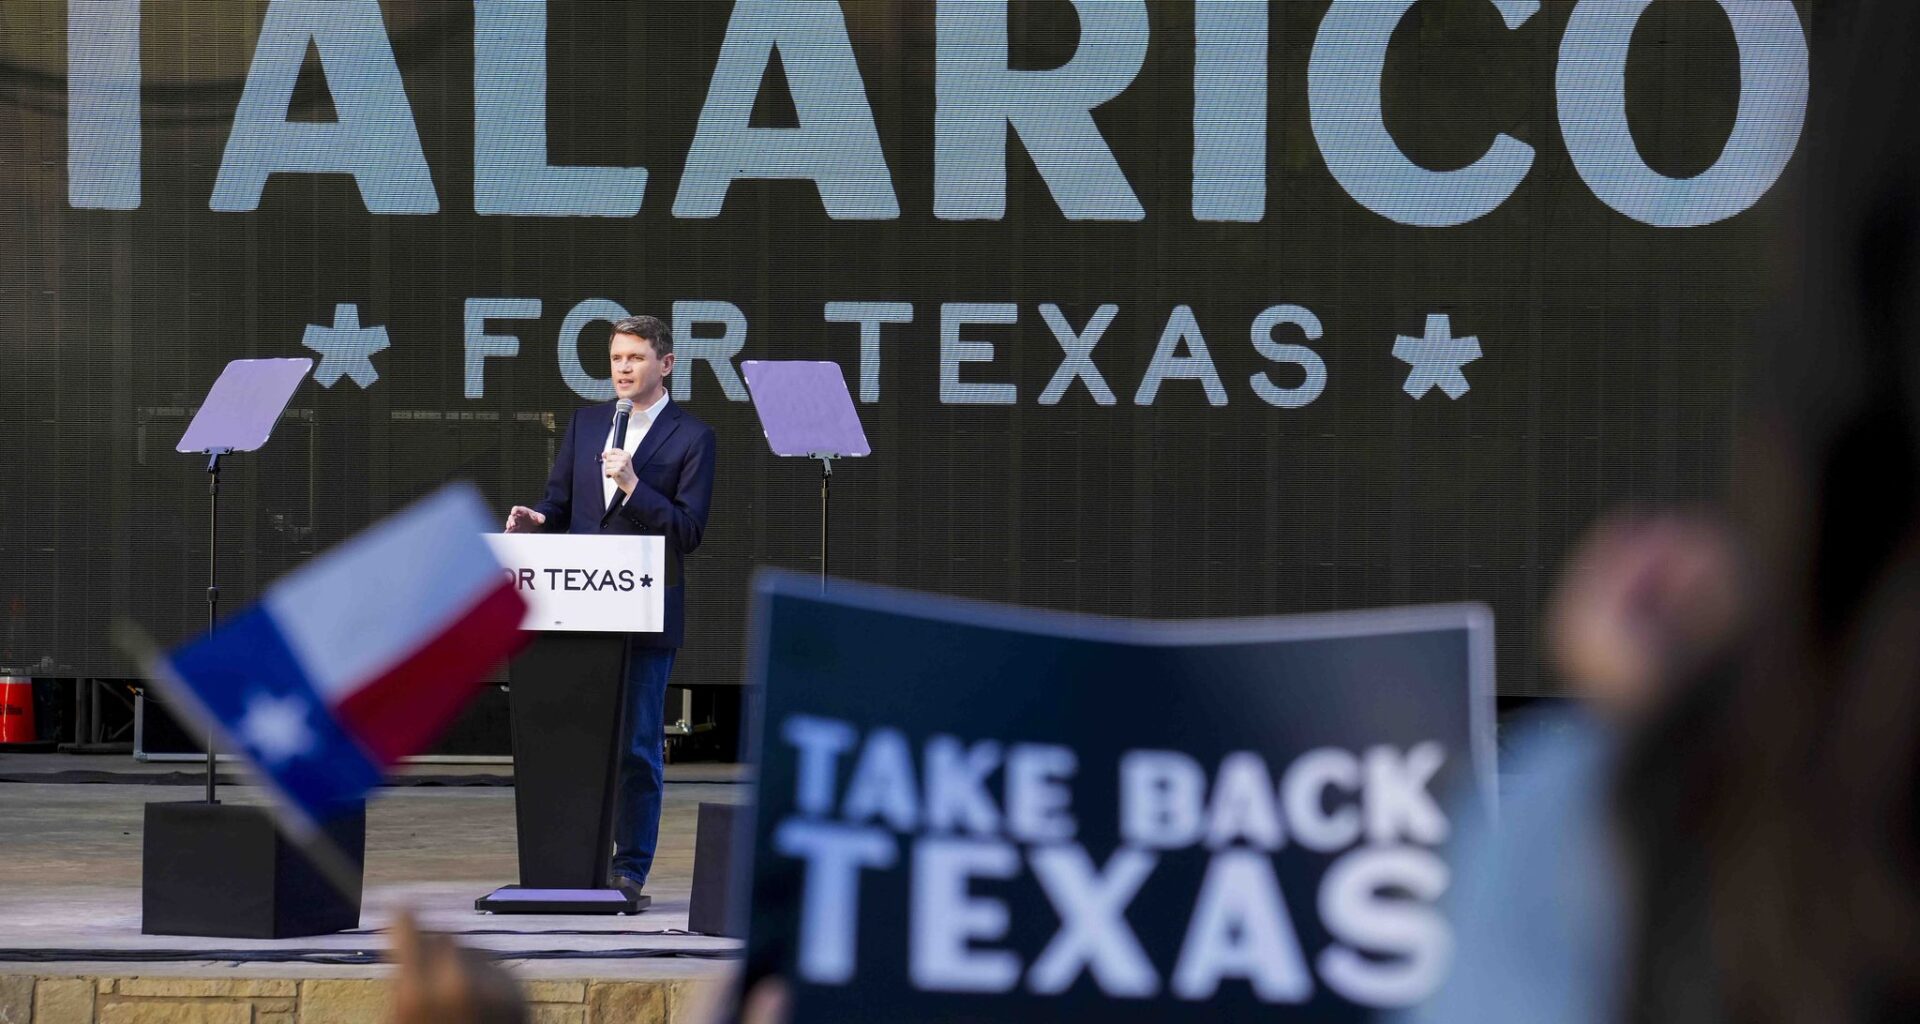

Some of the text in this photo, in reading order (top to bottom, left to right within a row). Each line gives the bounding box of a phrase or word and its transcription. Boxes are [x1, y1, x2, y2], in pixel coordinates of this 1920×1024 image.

[463, 297, 1328, 409] FOR TEXAS
[502, 567, 635, 592] OR TEXAS
[780, 714, 1452, 854] TAKE BACK
[774, 817, 1455, 1010] TEXAS
